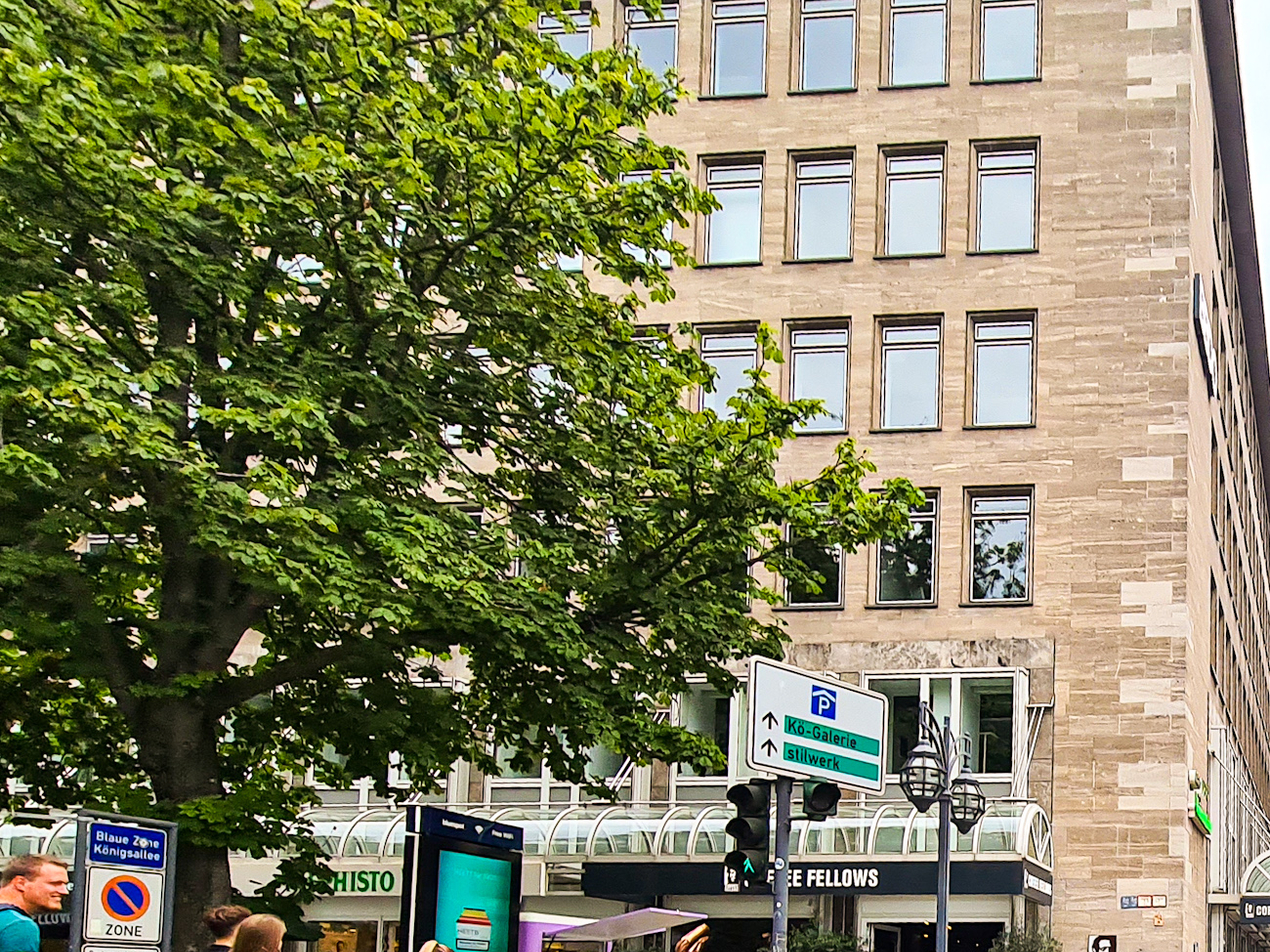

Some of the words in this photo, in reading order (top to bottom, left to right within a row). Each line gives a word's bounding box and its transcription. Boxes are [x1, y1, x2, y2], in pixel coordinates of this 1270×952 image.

[787, 717, 858, 749] Kö-Galerie
[787, 747, 841, 771] stilwerk
[95, 830, 130, 845] Blaue
[93, 843, 161, 862] Königsallee
[333, 870, 395, 893] HISTO
[806, 868, 879, 888] FELLOWS
[105, 923, 143, 937] ZONE
